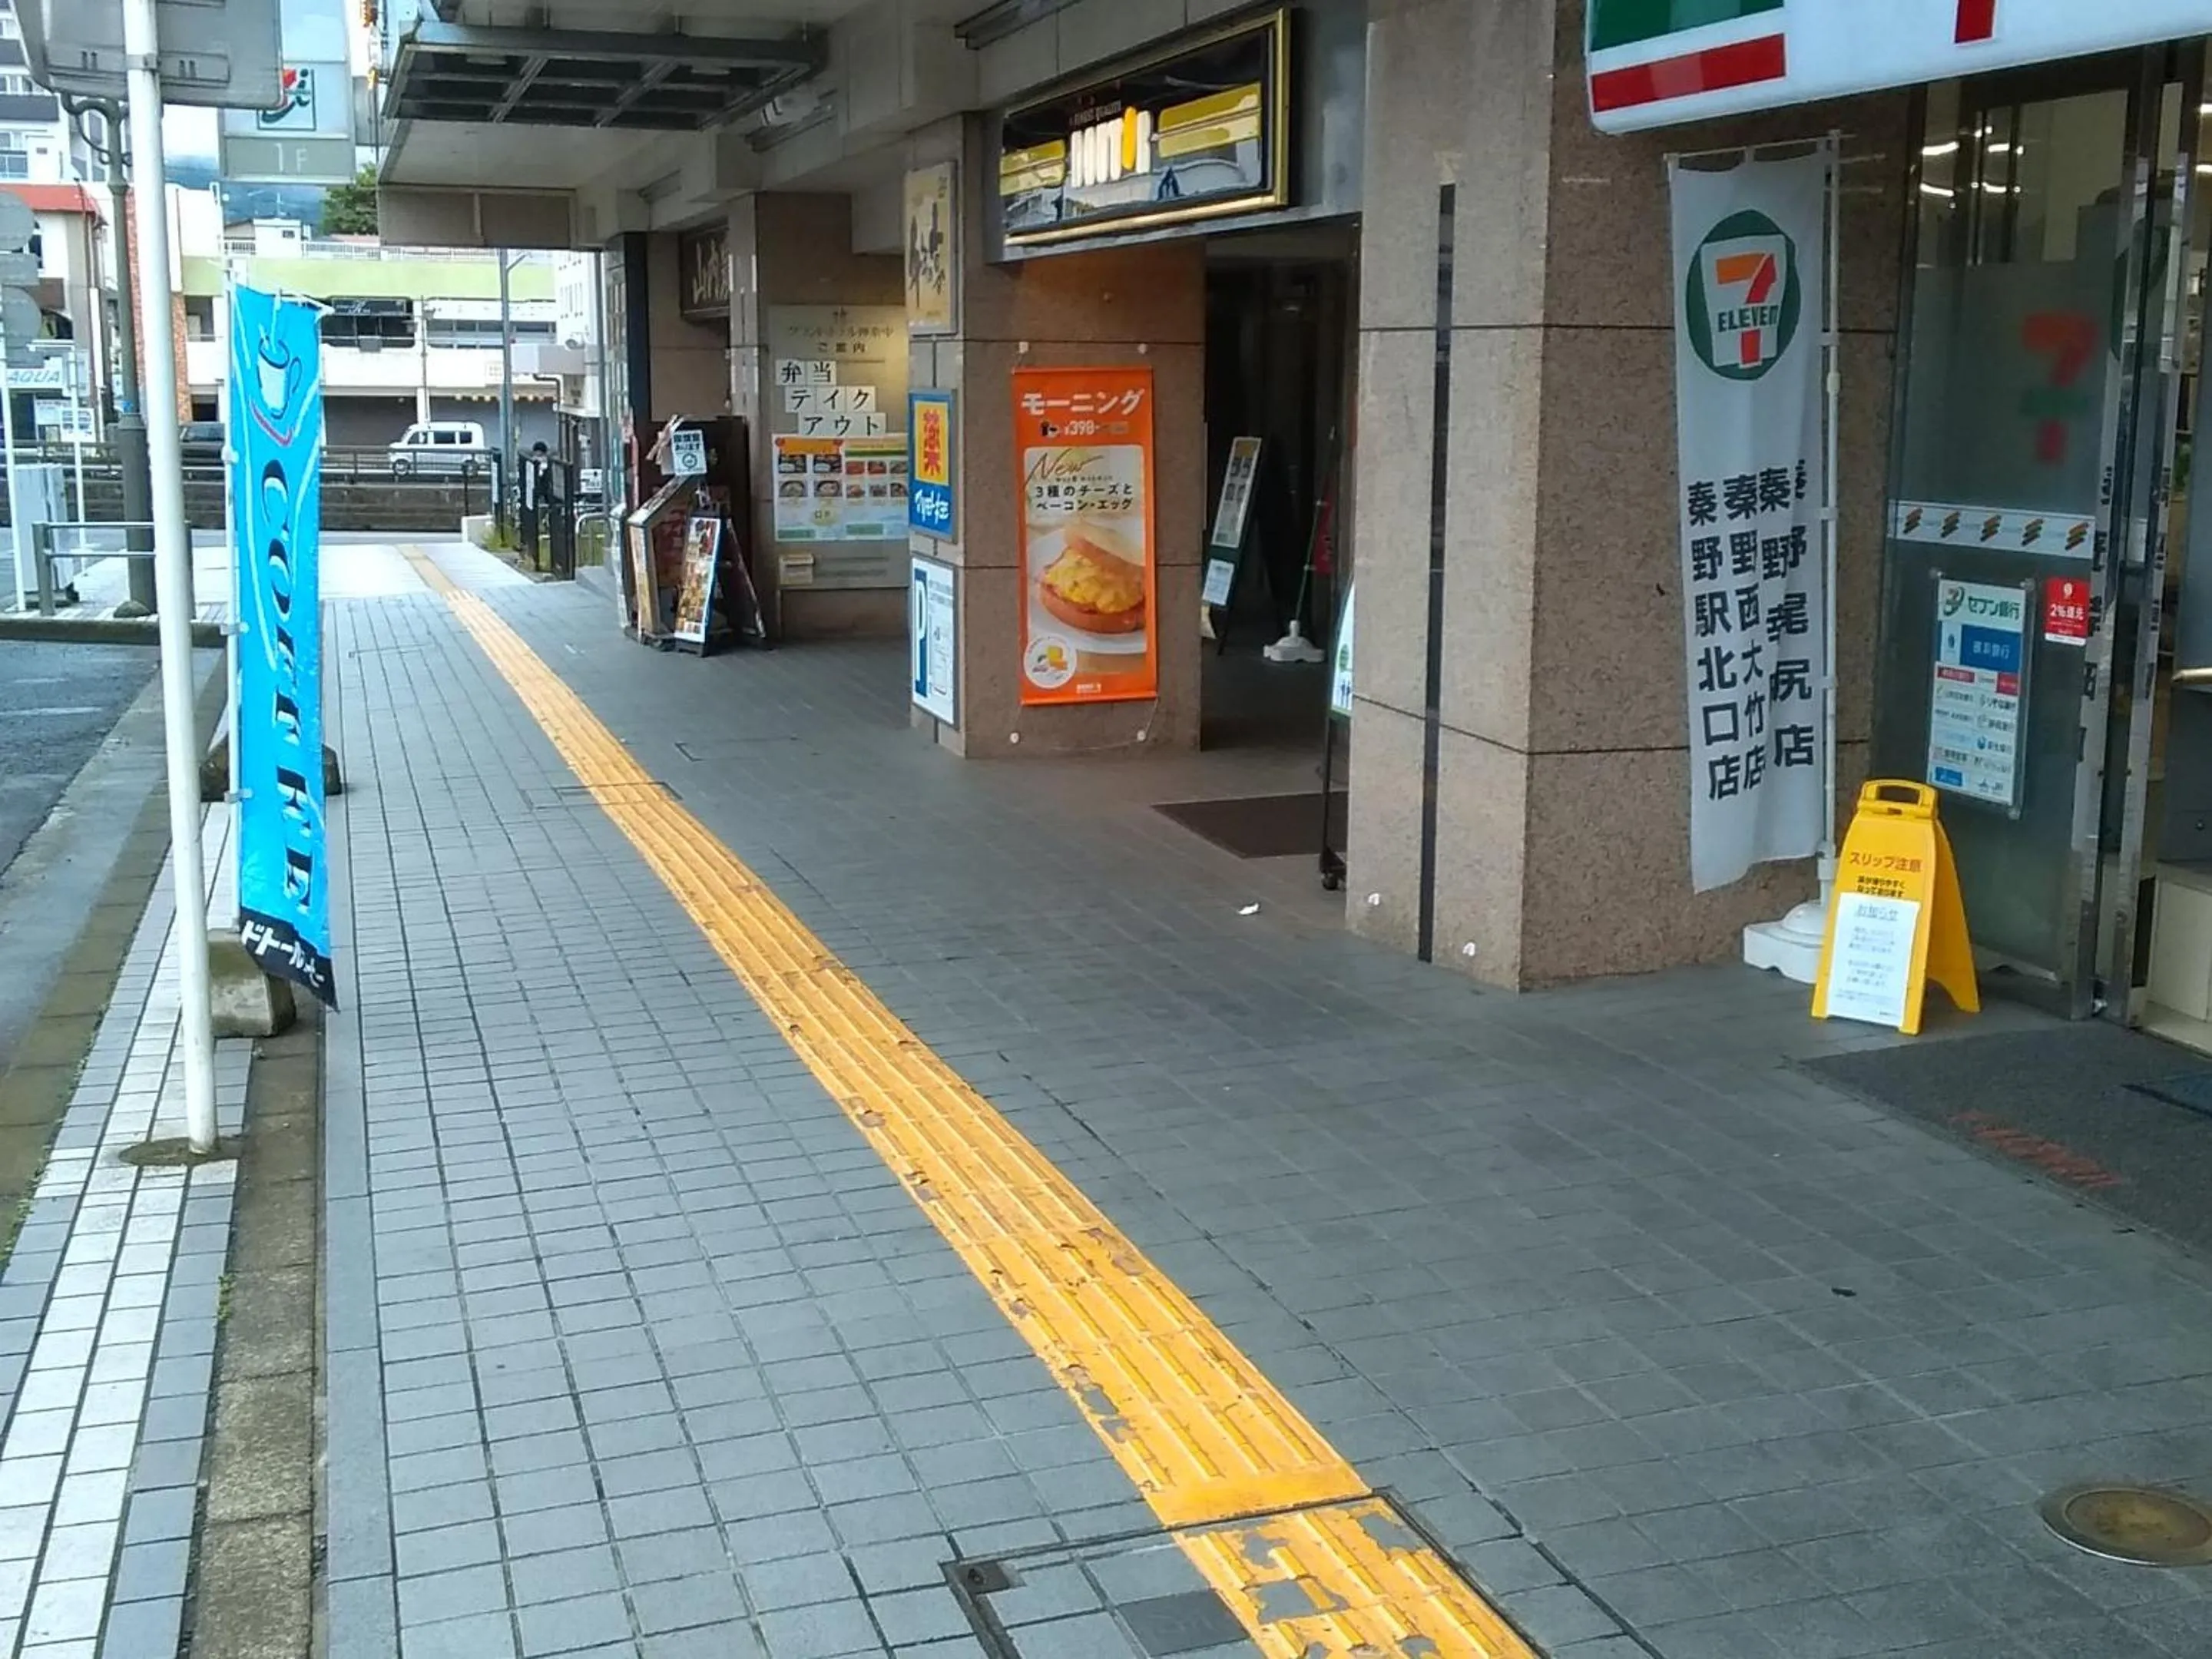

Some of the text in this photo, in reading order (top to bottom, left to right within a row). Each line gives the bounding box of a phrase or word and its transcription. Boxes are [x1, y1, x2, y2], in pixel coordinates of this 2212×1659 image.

[781, 361, 832, 383] 弁当
[790, 389, 869, 410] テイク
[1021, 388, 1145, 416] モーニング
[803, 416, 879, 436] アウト
[1035, 483, 1133, 498] 3種のチーズと
[1036, 498, 1133, 511] ベーコン・エッグ
[1688, 480, 1740, 800] 秦野駅北口店
[1849, 851, 1922, 873] スリップ注意
